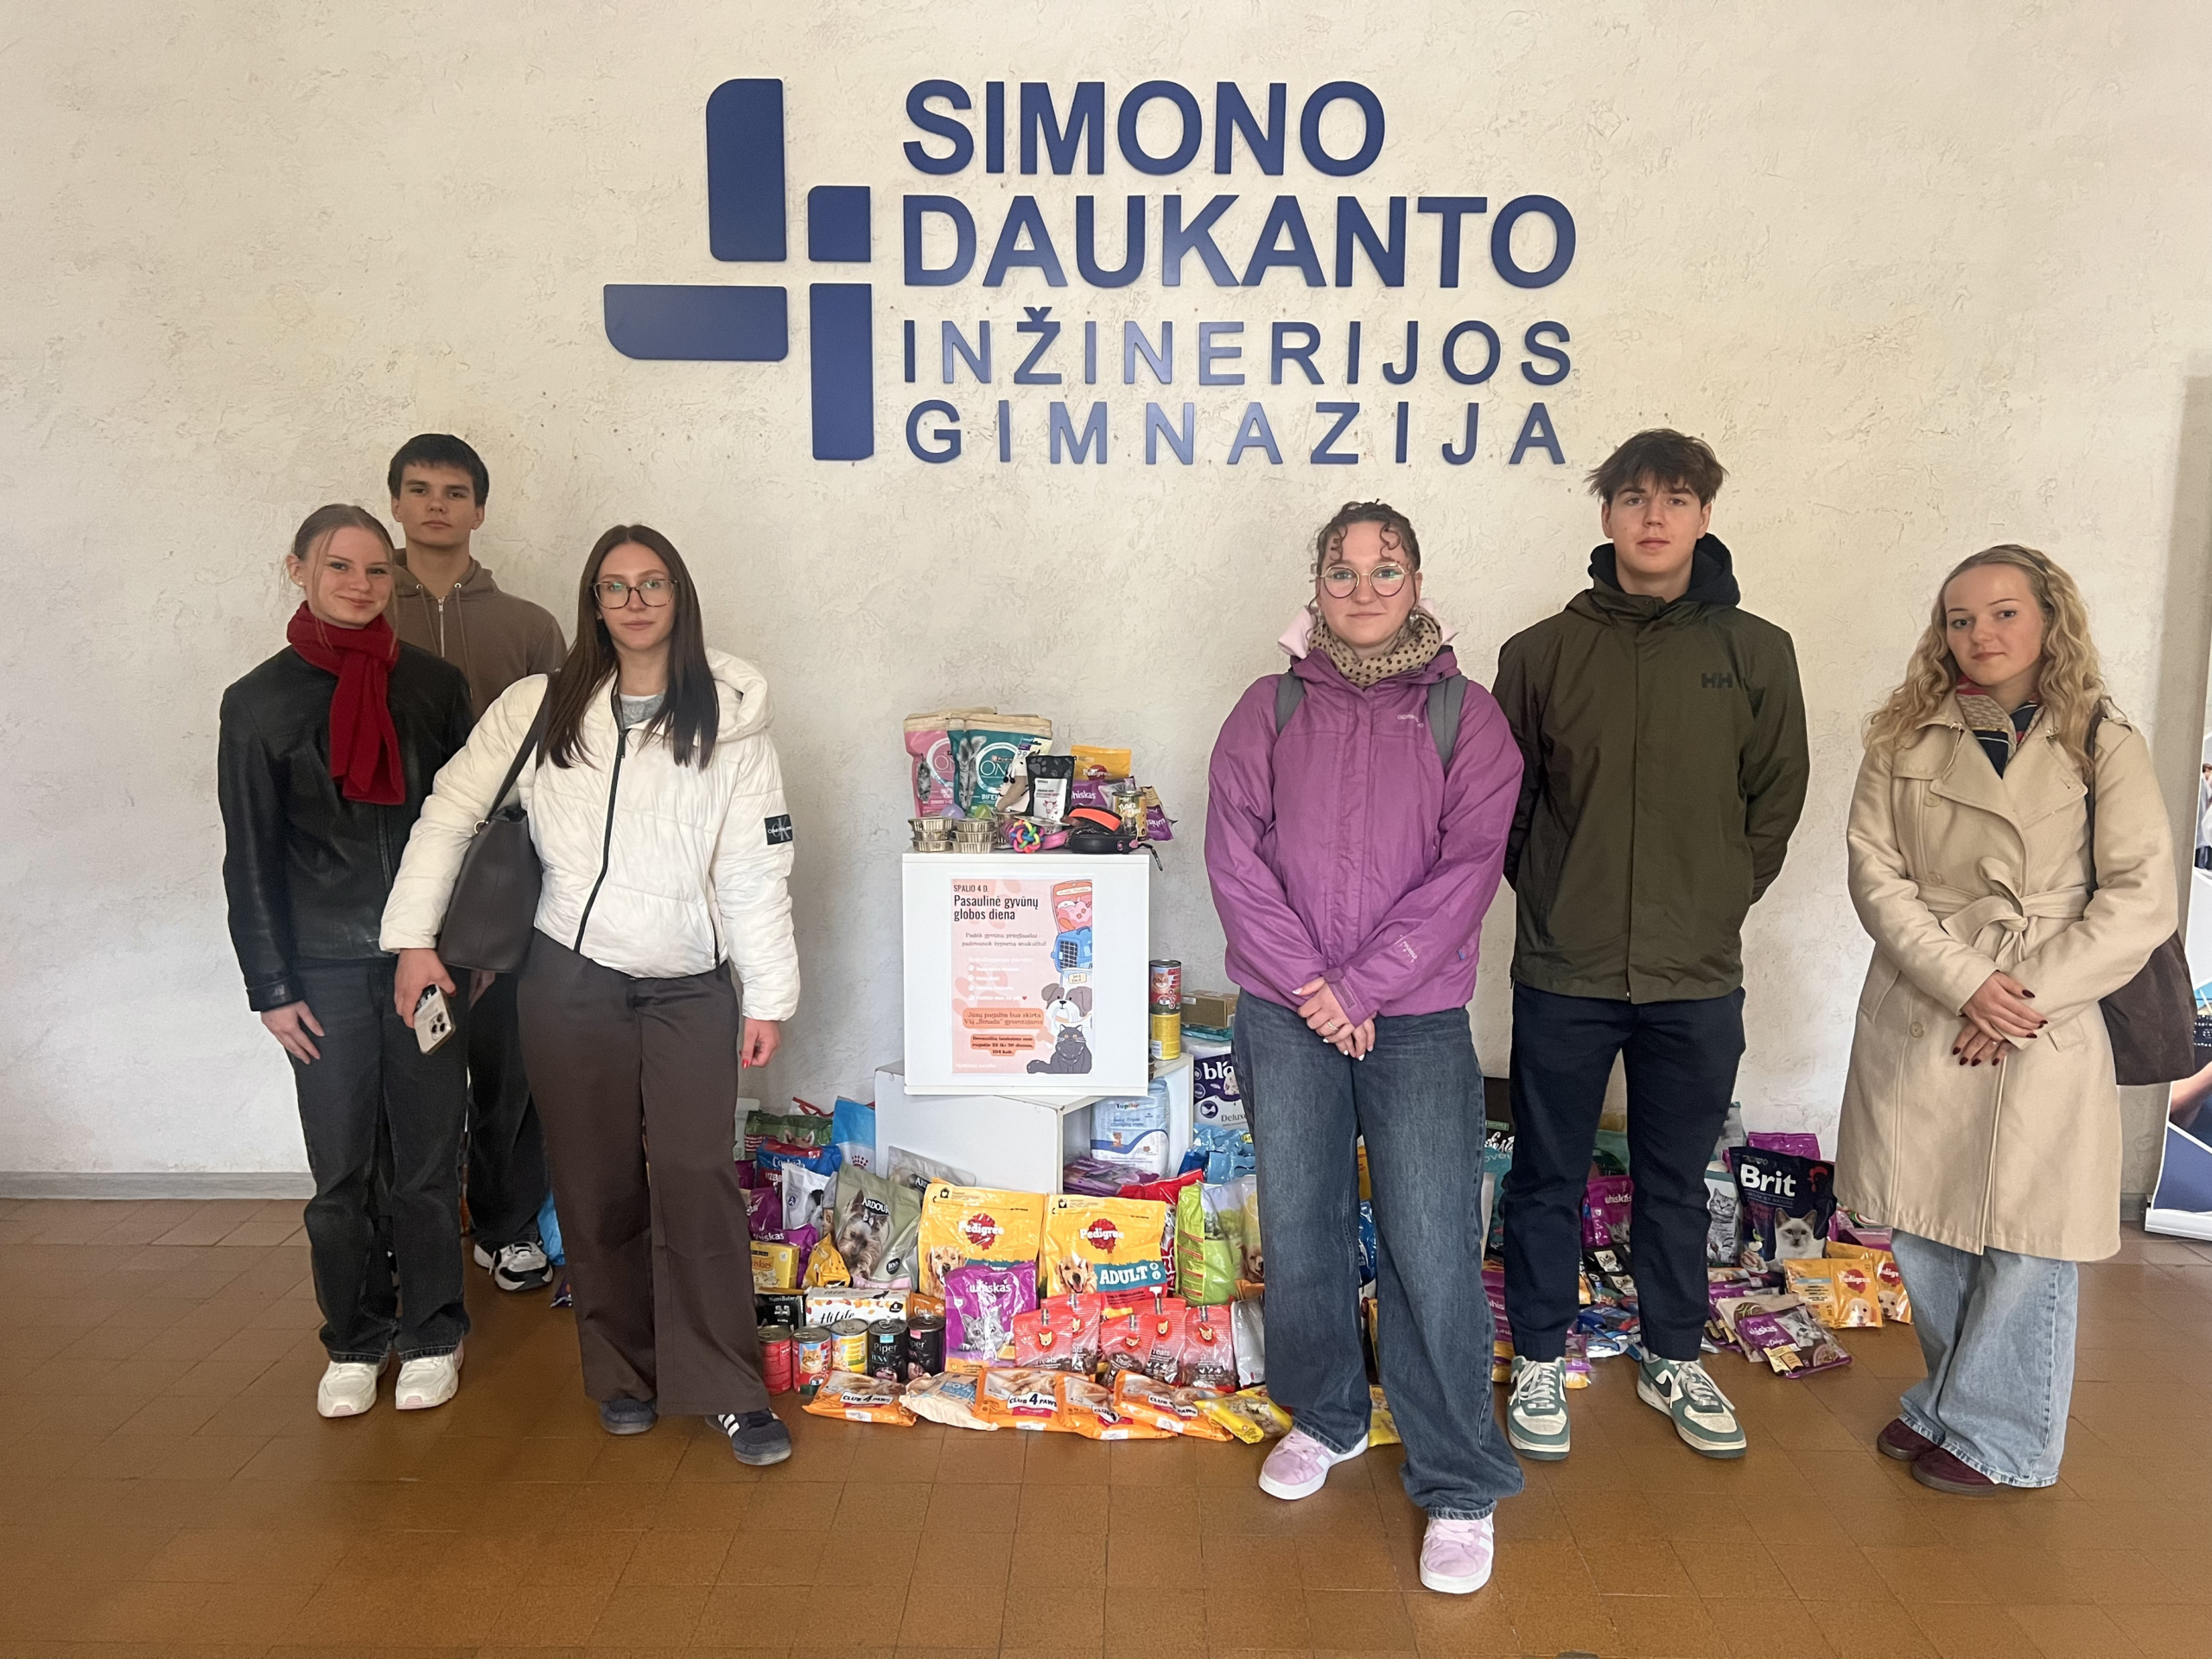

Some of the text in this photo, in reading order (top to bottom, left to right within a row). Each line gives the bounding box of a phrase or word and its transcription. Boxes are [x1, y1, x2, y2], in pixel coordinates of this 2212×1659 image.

[902, 78, 1385, 178] SIMONO
[902, 193, 1578, 289] DAUKANTO
[903, 306, 1573, 386] INŽINERIJOS
[904, 398, 1567, 465] GIMNAZIJA
[1071, 789, 1096, 800] hiskas
[953, 884, 976, 893] SPALIO
[953, 894, 1039, 910] Pasaulinė gyvūnų
[953, 908, 1016, 922] globos diena
[1221, 1112, 1247, 1122] Delux
[1740, 1163, 1796, 1198] Brit
[957, 1220, 1005, 1236] Pedigree
[1078, 1227, 1125, 1241] Pedigree
[753, 1259, 772, 1269] iskies
[1099, 1266, 1148, 1286] ADULT
[969, 1279, 1012, 1294] whiskas
[874, 1342, 898, 1355] Piper
[1029, 1393, 1039, 1405] 4
[1039, 1398, 1058, 1408] PAWS
[1149, 1396, 1168, 1406] CLUB
